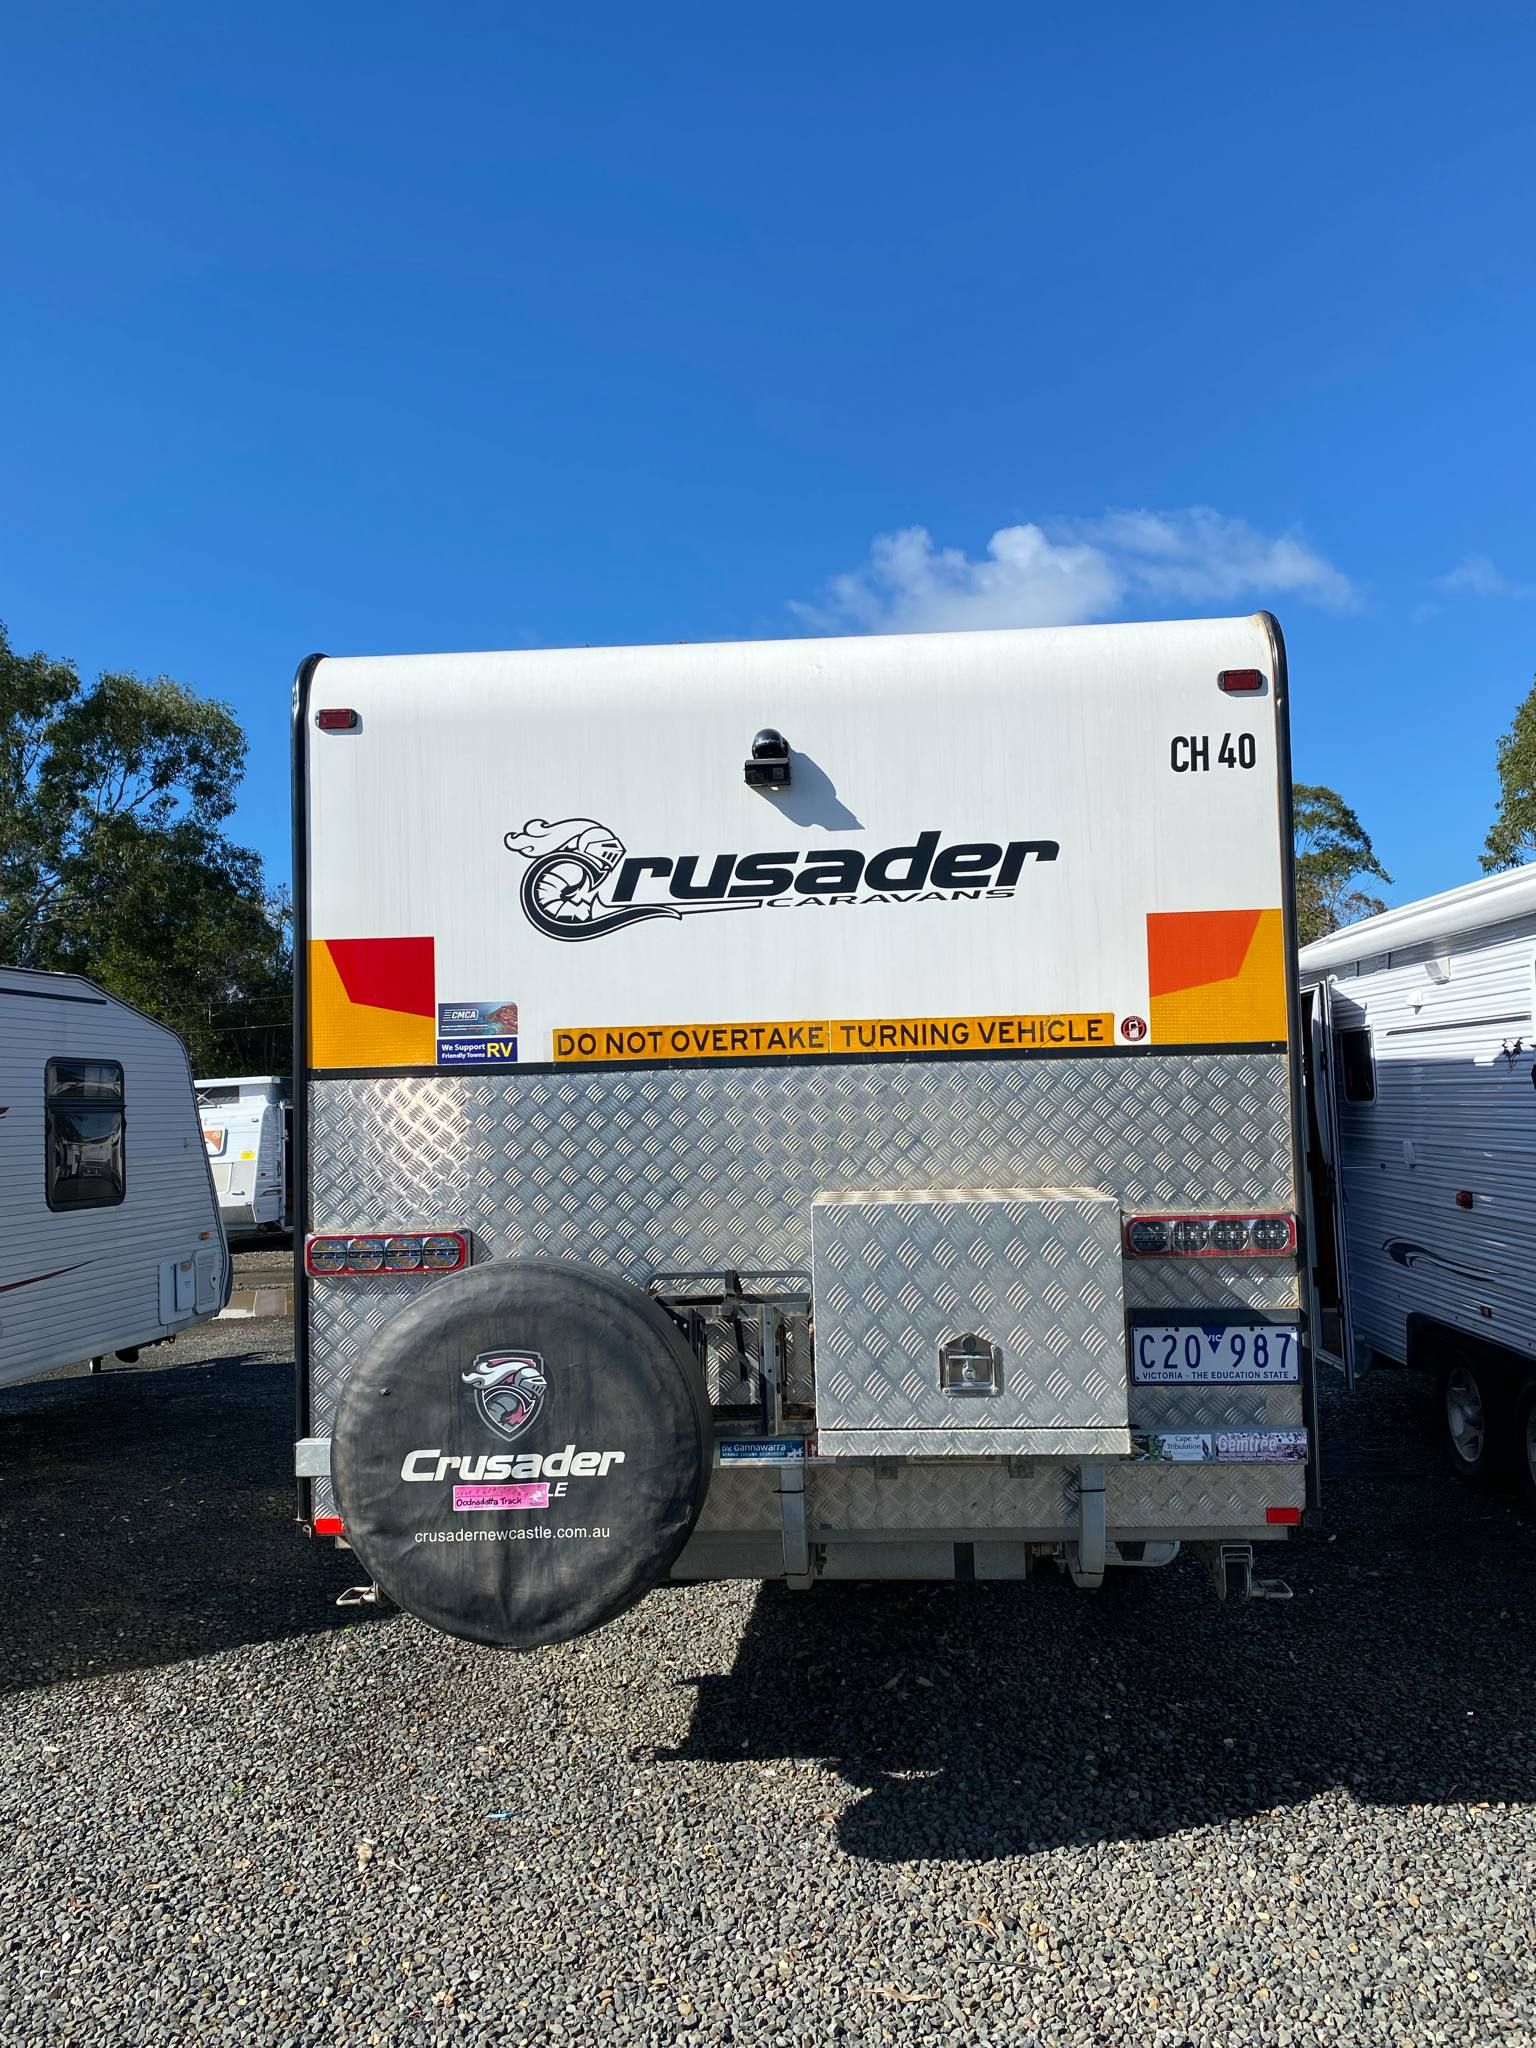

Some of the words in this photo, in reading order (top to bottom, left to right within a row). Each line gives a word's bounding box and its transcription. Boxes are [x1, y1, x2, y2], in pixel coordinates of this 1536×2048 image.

[1170, 735, 1210, 773] CH
[1217, 732, 1257, 770] 40
[765, 888, 1017, 908] CARAVANS
[451, 1010, 476, 1019] CMCA
[556, 1032, 597, 1056] DO
[606, 1030, 663, 1054] NOT
[670, 1026, 824, 1052] OVERTAKE
[840, 1021, 970, 1047] TURNING
[977, 1018, 1104, 1044] VEHICLE
[454, 1043, 486, 1052] Support
[486, 1041, 513, 1058] RV
[1206, 1334, 1223, 1342] VIC
[1139, 1333, 1202, 1369] C20
[1230, 1333, 1292, 1369] 987
[1142, 1372, 1183, 1380] VICTORIA
[1191, 1371, 1209, 1379] THE
[1212, 1371, 1261, 1379] EDUCATION
[1263, 1371, 1289, 1379] STATE
[733, 1443, 786, 1452] Gannawarra
[1167, 1442, 1201, 1450] Tribulation
[1175, 1435, 1192, 1443] Cape
[1217, 1434, 1277, 1452] Gemtree
[400, 1444, 626, 1482] Crusader
[500, 1496, 522, 1505] Track
[414, 1525, 611, 1543] crusadernewcastle.com.au
